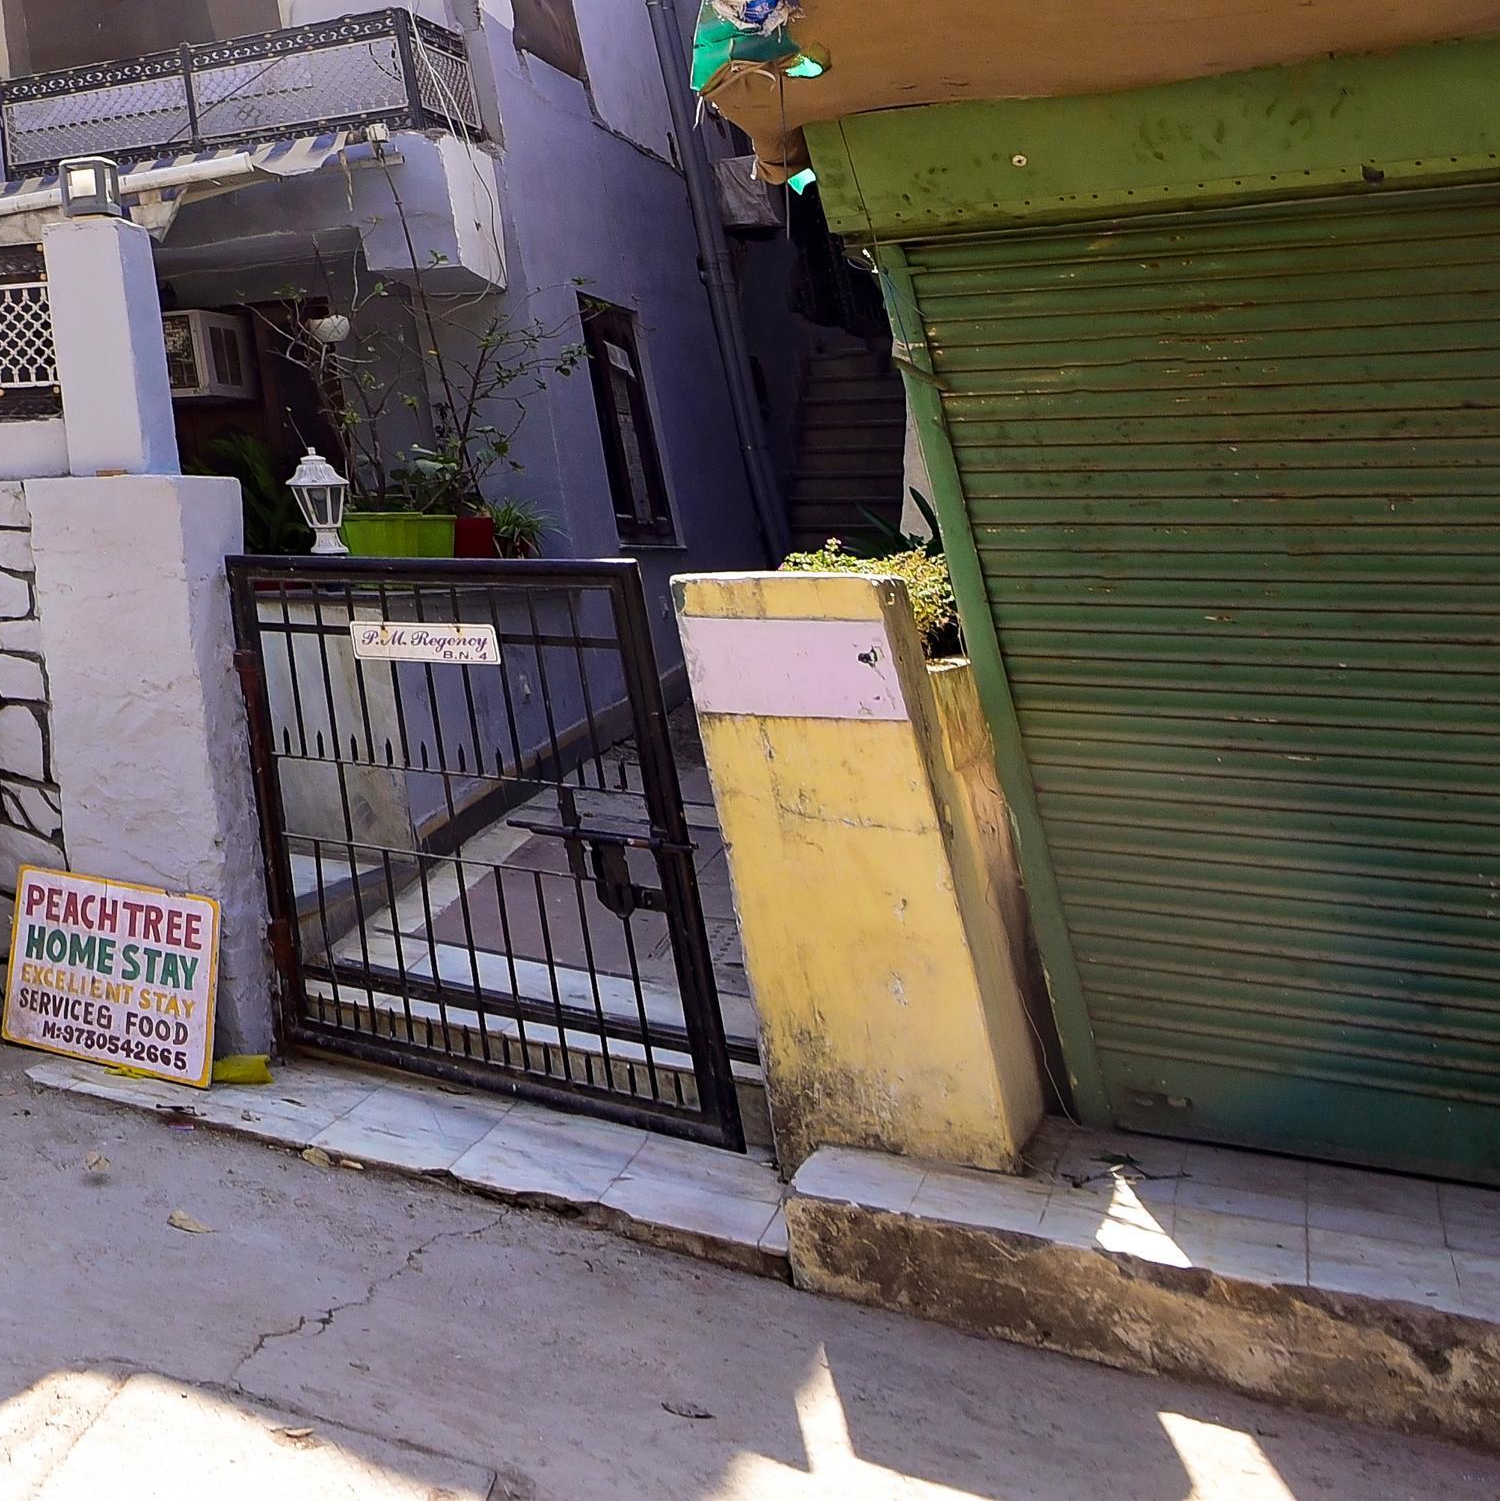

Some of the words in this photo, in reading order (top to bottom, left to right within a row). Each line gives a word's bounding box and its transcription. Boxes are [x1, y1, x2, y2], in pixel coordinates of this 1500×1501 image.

[361, 629, 407, 646] P.M.
[443, 650, 474, 660] B.N.
[479, 652, 488, 661] 4
[138, 988, 196, 1019] STAY
[19, 988, 94, 1026] SERVICE
[124, 1011, 189, 1046] FOOD
